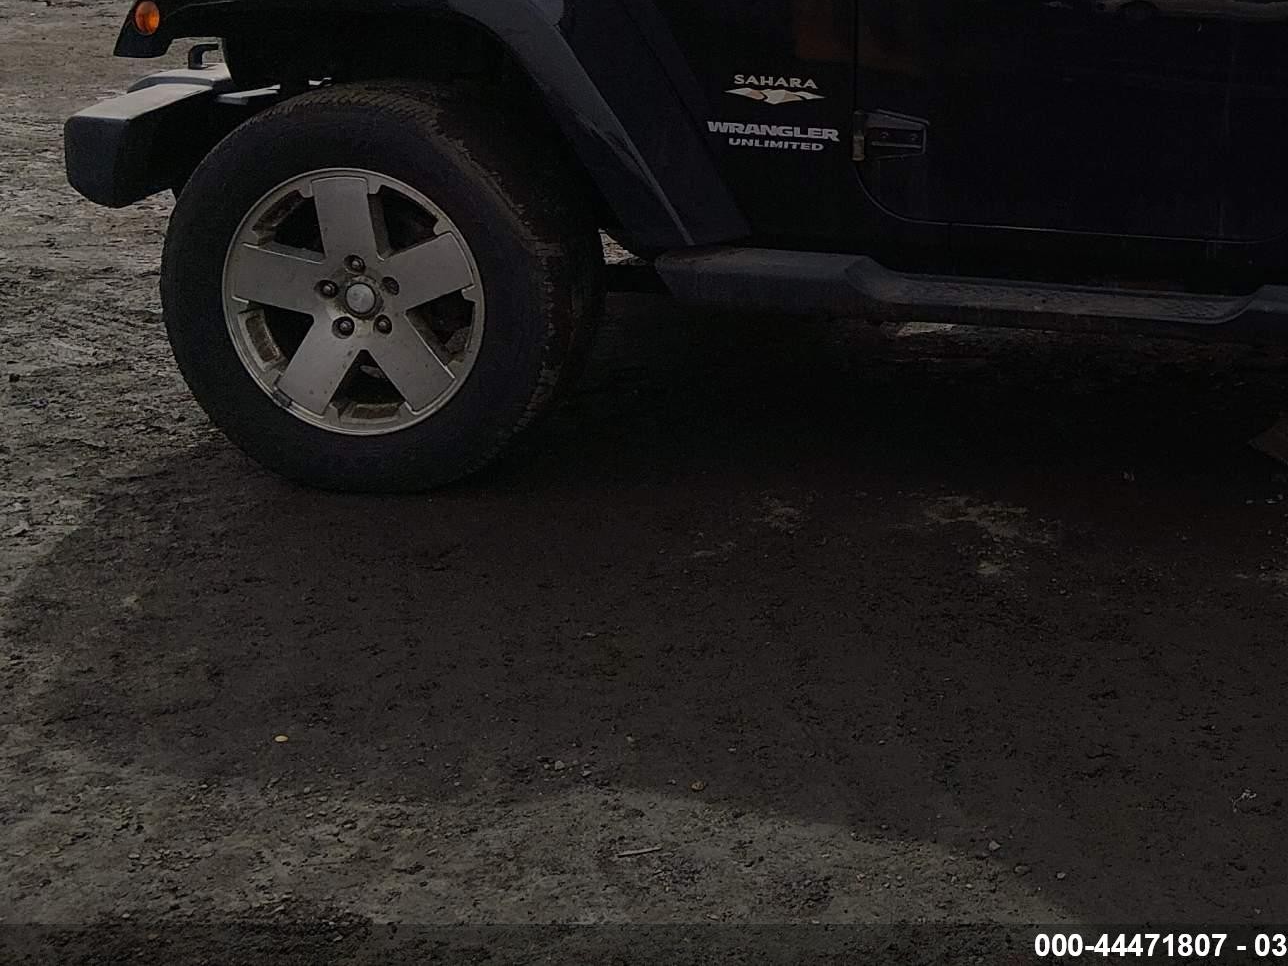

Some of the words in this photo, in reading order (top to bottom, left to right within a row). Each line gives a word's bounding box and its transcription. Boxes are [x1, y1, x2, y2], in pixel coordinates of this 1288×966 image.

[734, 74, 818, 89] SAHARA
[707, 121, 840, 142] WRANGLER
[728, 137, 824, 151] UNLIMITED
